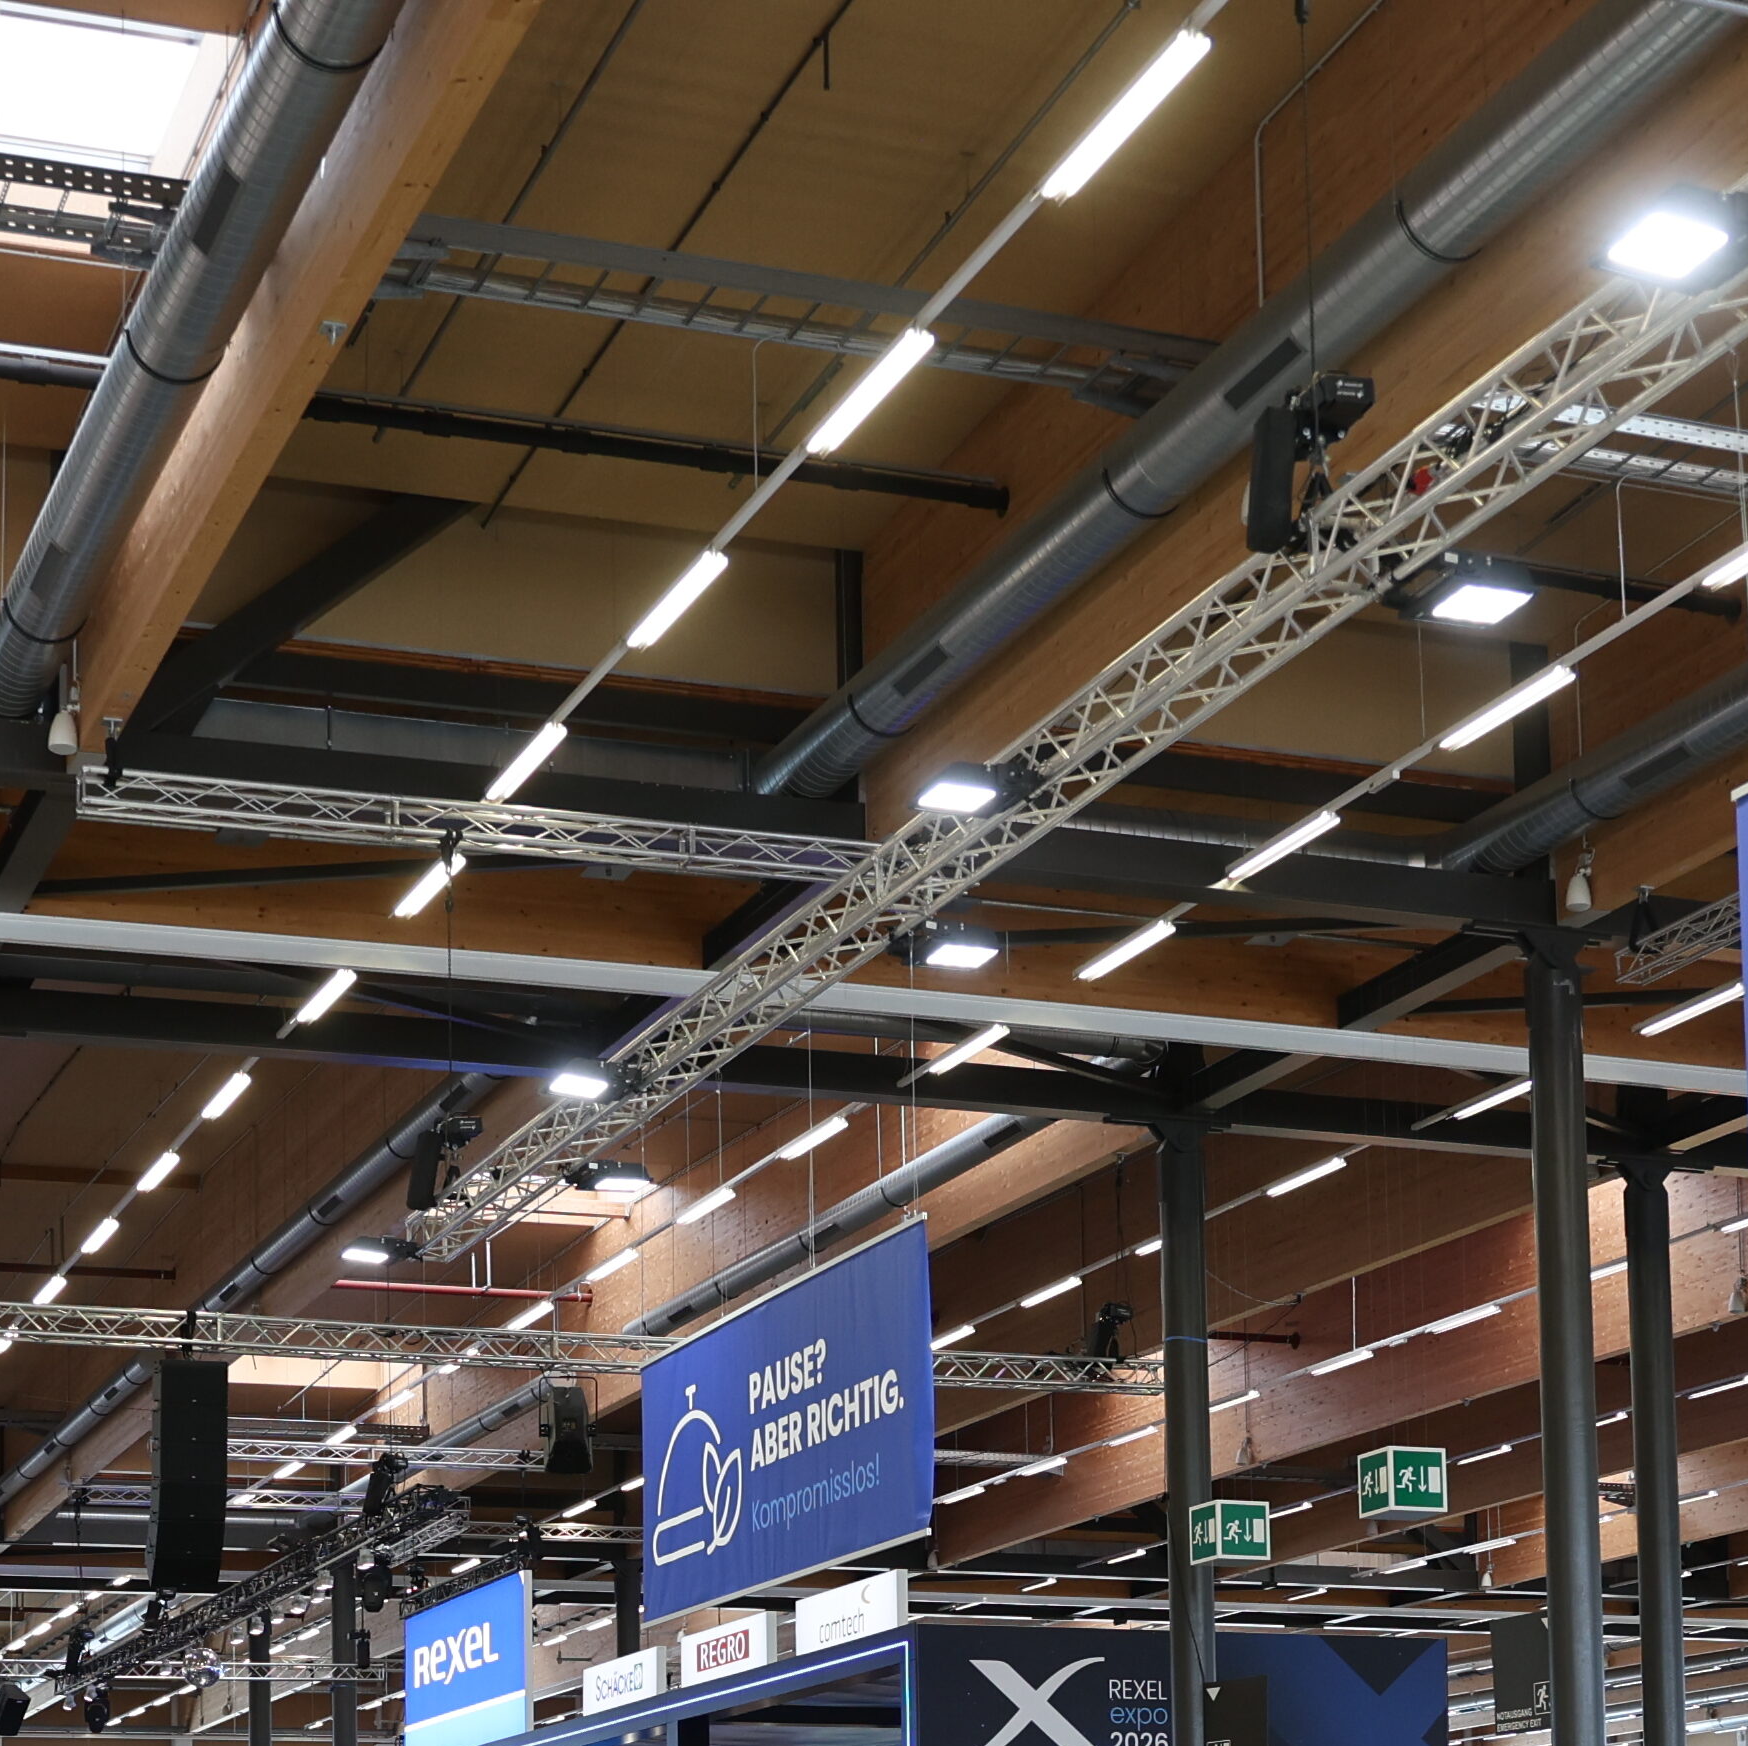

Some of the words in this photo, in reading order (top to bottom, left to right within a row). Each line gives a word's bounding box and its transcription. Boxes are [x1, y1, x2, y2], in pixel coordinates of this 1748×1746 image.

[749, 1338, 827, 1414] PAUSE?
[751, 1419, 802, 1472] ABER
[807, 1368, 904, 1449] RICHTIG.
[752, 1452, 881, 1533] Kompromisslos!
[819, 1609, 865, 1645] comtech
[700, 1631, 746, 1670] REGRO
[1109, 1679, 1168, 1700] REXEL
[1110, 1706, 1168, 1731] expo
[1496, 1708, 1533, 1720] NOTAUSGANG
[1530, 1718, 1542, 1728] EXIT
